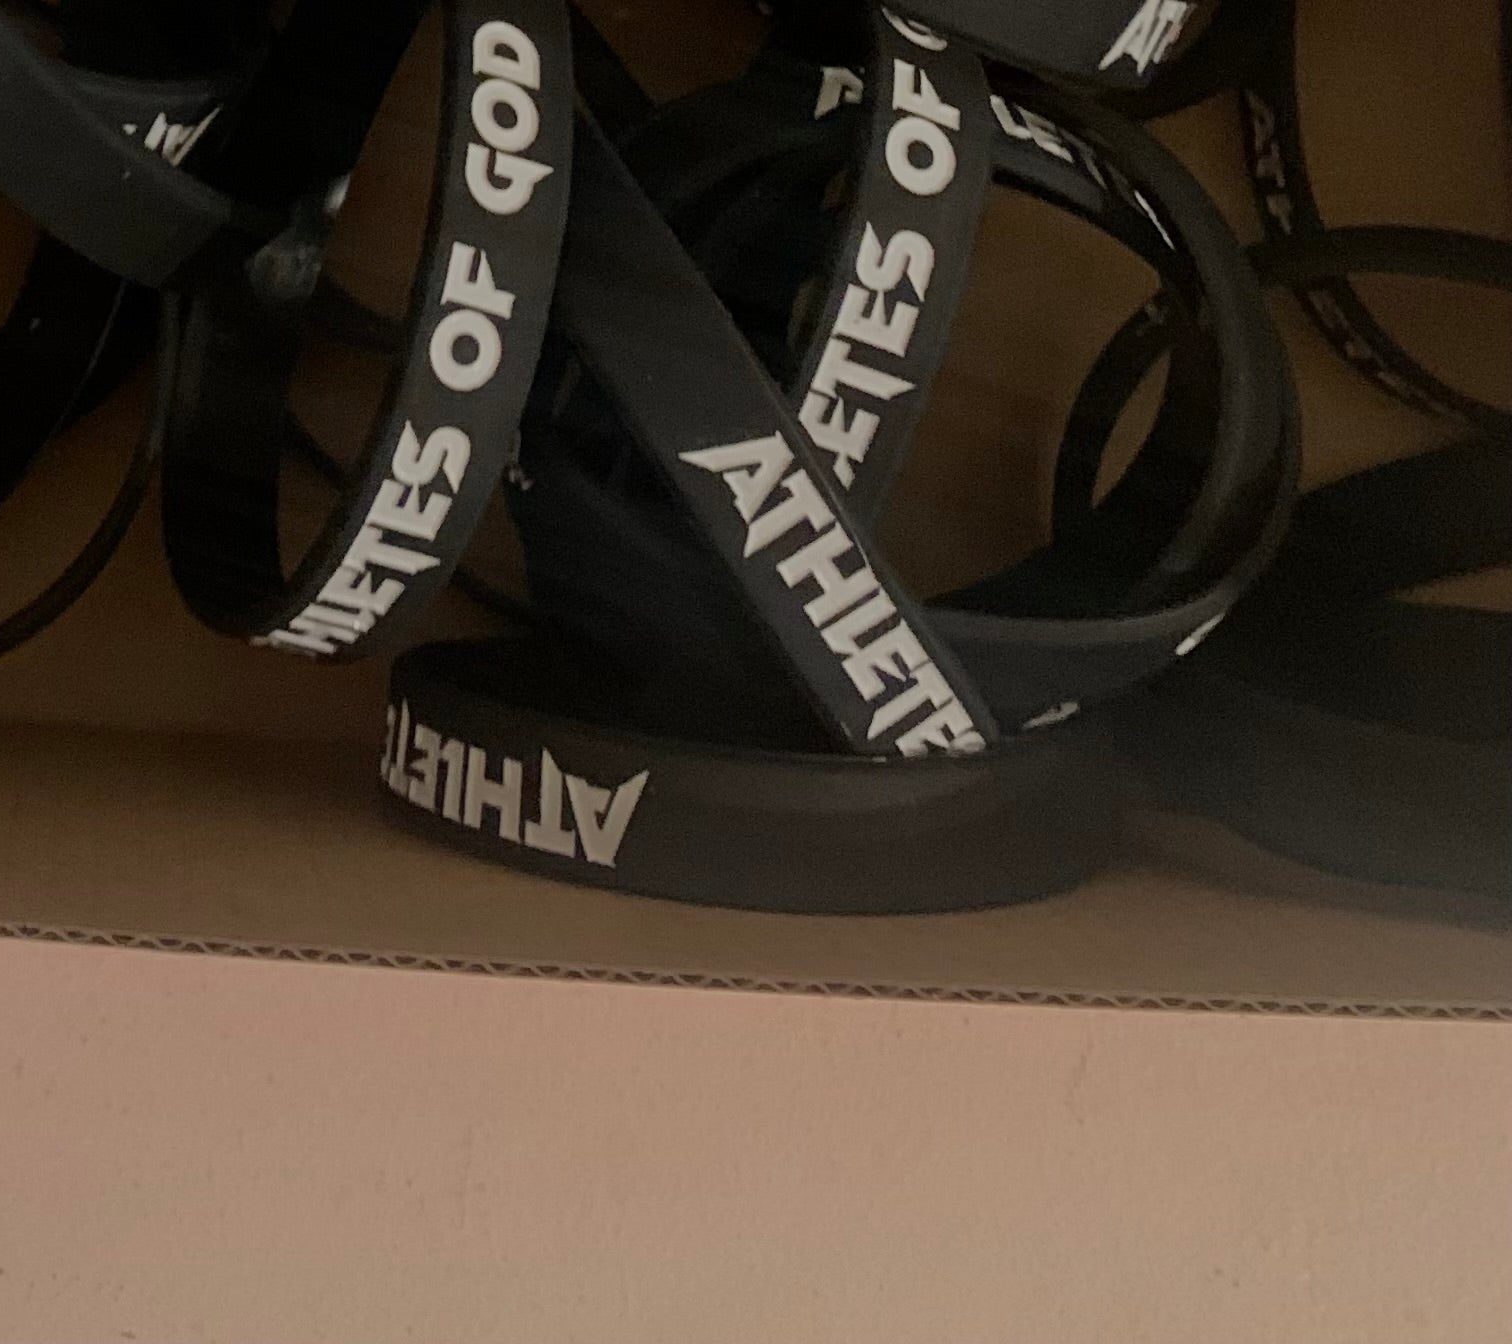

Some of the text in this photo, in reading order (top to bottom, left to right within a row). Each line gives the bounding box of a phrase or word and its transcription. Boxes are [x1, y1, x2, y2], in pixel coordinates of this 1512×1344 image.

[250, 20, 555, 657] HLETES OF GOD
[798, 220, 936, 490] ETES
[886, 58, 961, 197] OF
